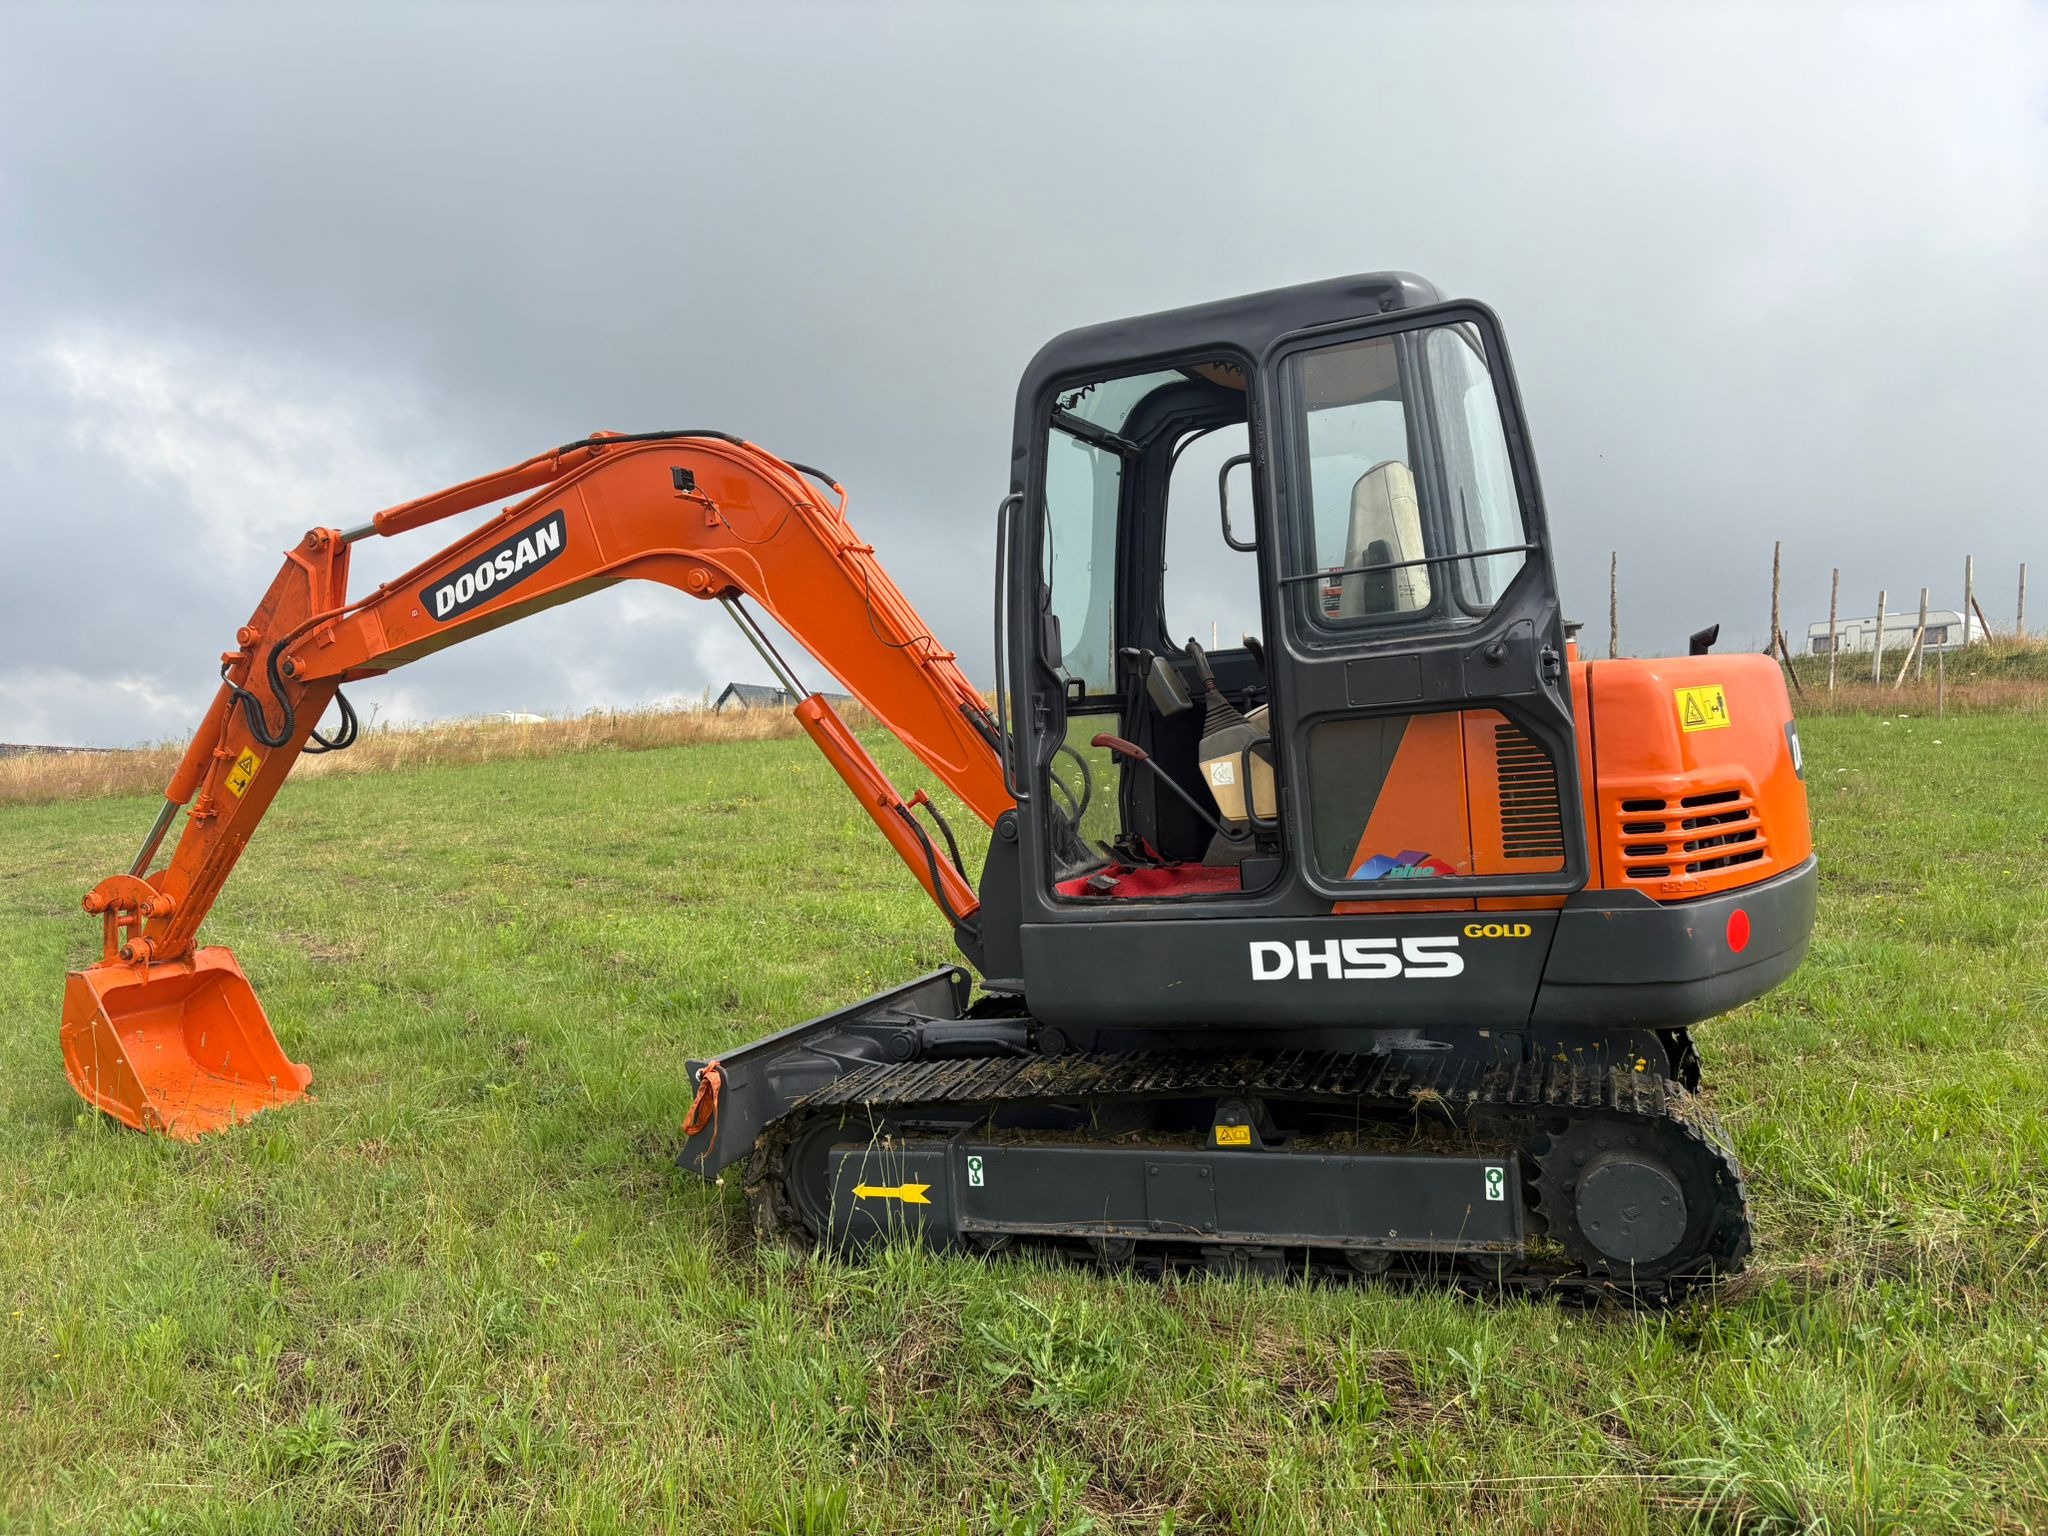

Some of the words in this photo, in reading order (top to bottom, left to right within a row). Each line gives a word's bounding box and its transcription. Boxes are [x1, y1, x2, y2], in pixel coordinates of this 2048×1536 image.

[435, 520, 561, 618] DOOSAN
[1249, 936, 1465, 981] DH55
[1463, 923, 1532, 938] GOLD
